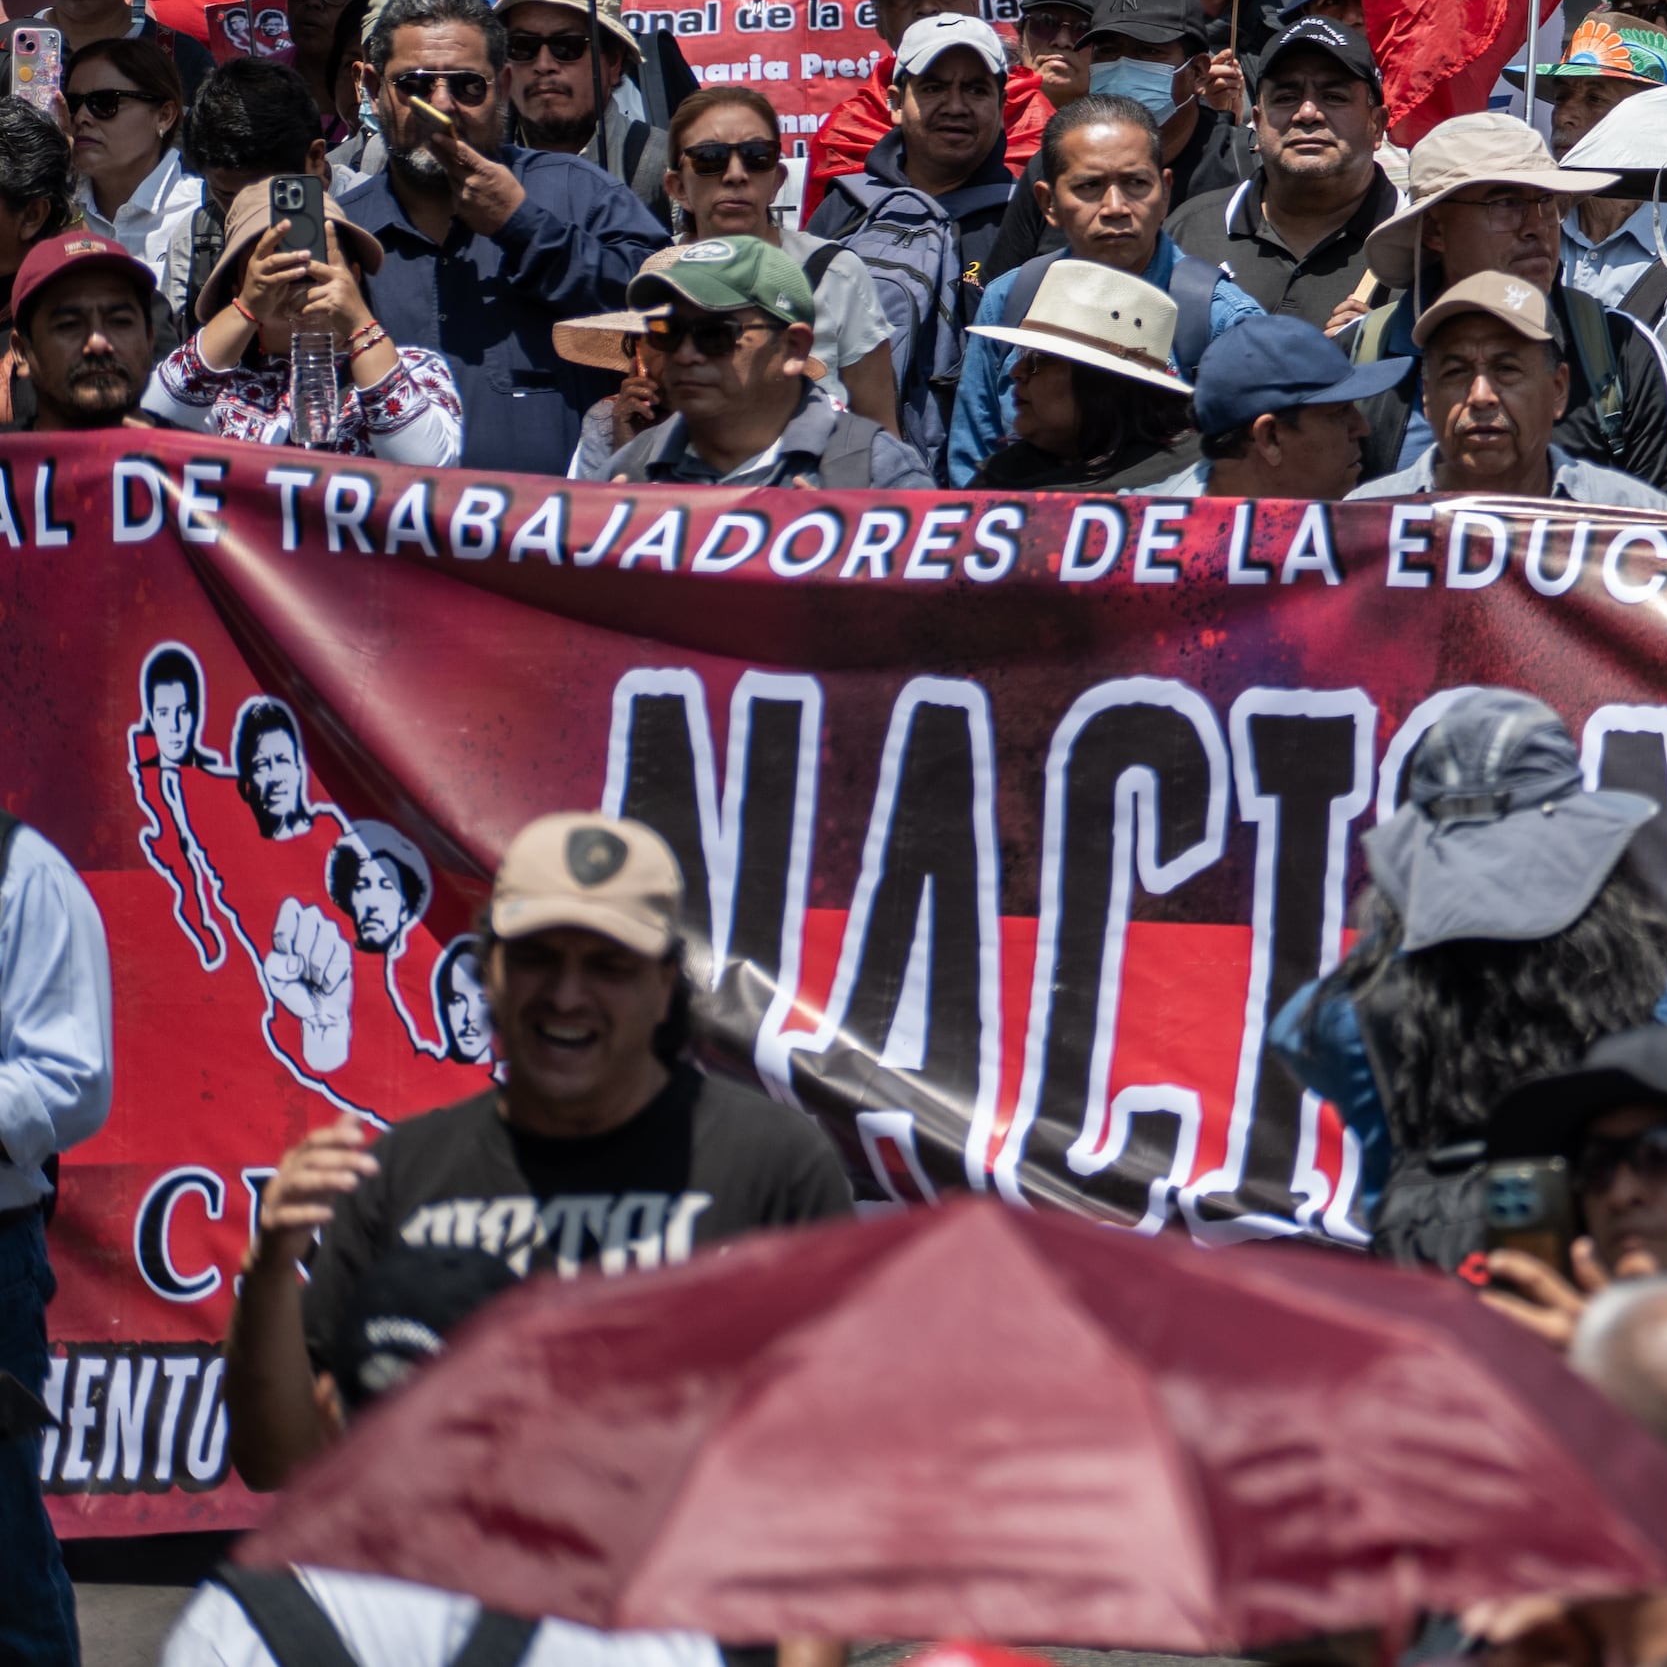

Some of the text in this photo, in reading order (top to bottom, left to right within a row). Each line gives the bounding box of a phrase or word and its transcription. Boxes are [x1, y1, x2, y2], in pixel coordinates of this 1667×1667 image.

[735, 0, 796, 33] de
[112, 460, 224, 542] DE
[265, 466, 1021, 583] TRABAJADORES
[1058, 502, 1191, 583] DE
[1226, 502, 1342, 586] LA
